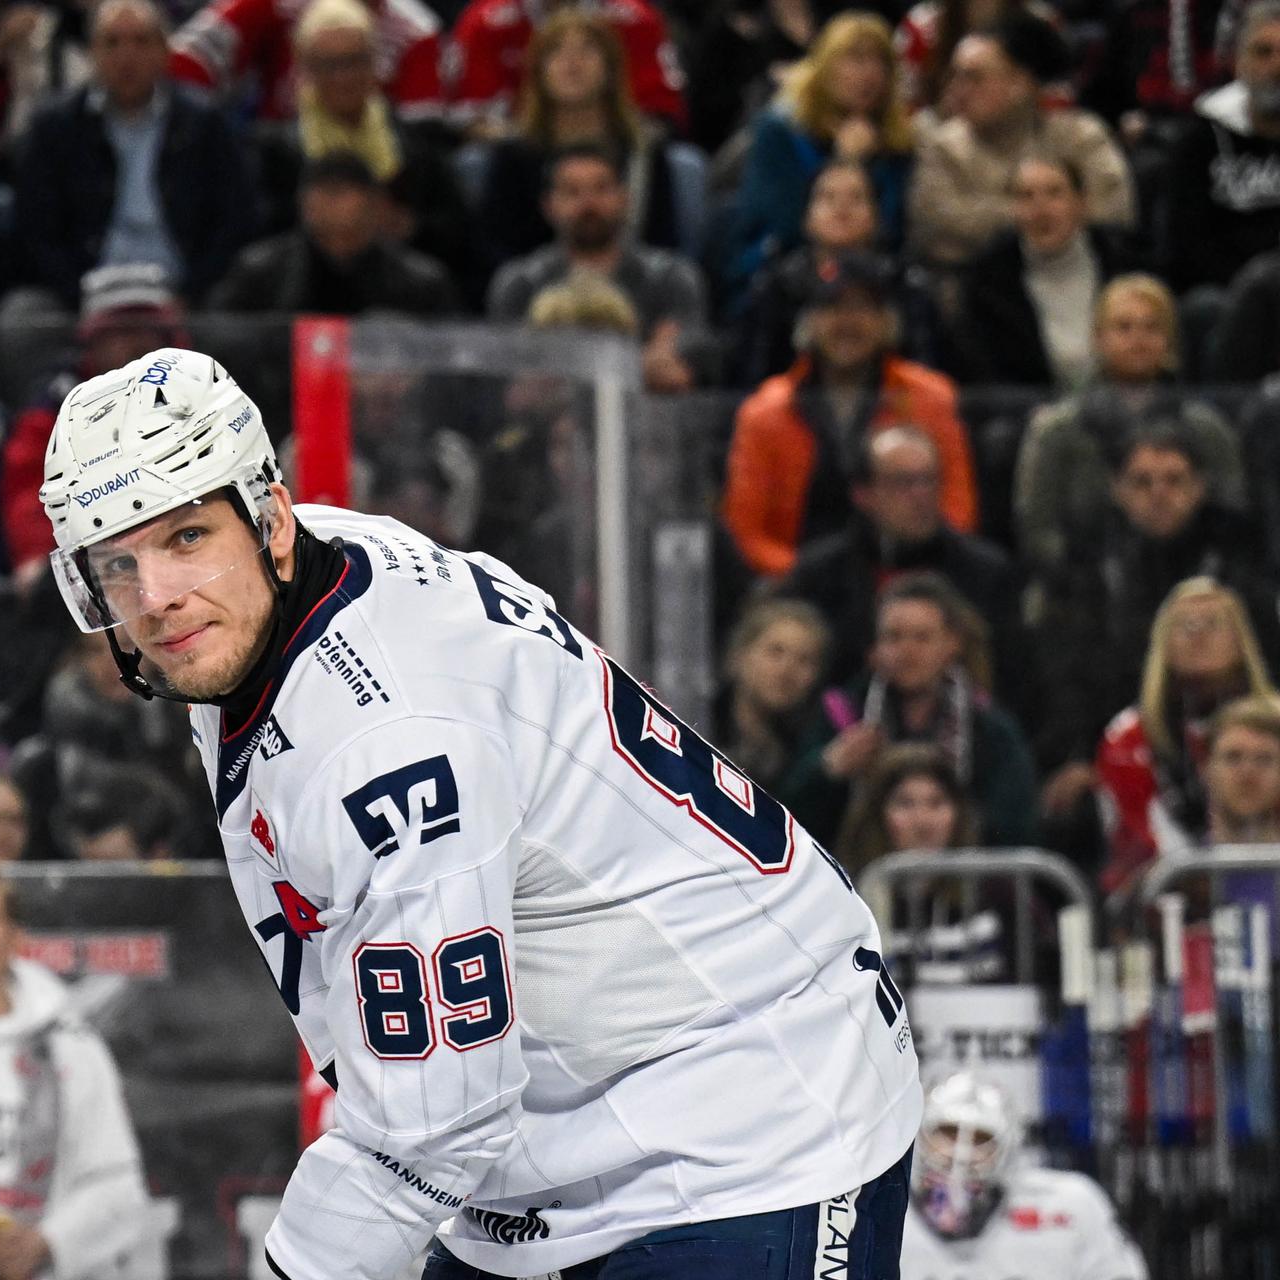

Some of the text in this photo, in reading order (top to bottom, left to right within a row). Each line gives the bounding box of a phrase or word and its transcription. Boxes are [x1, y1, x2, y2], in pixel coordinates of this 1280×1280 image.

[91, 468, 142, 502] DURAVIT
[319, 636, 373, 708] pfenning
[253, 881, 328, 942] A
[351, 925, 515, 1061] 89
[371, 1150, 466, 1210] MANNHEIM
